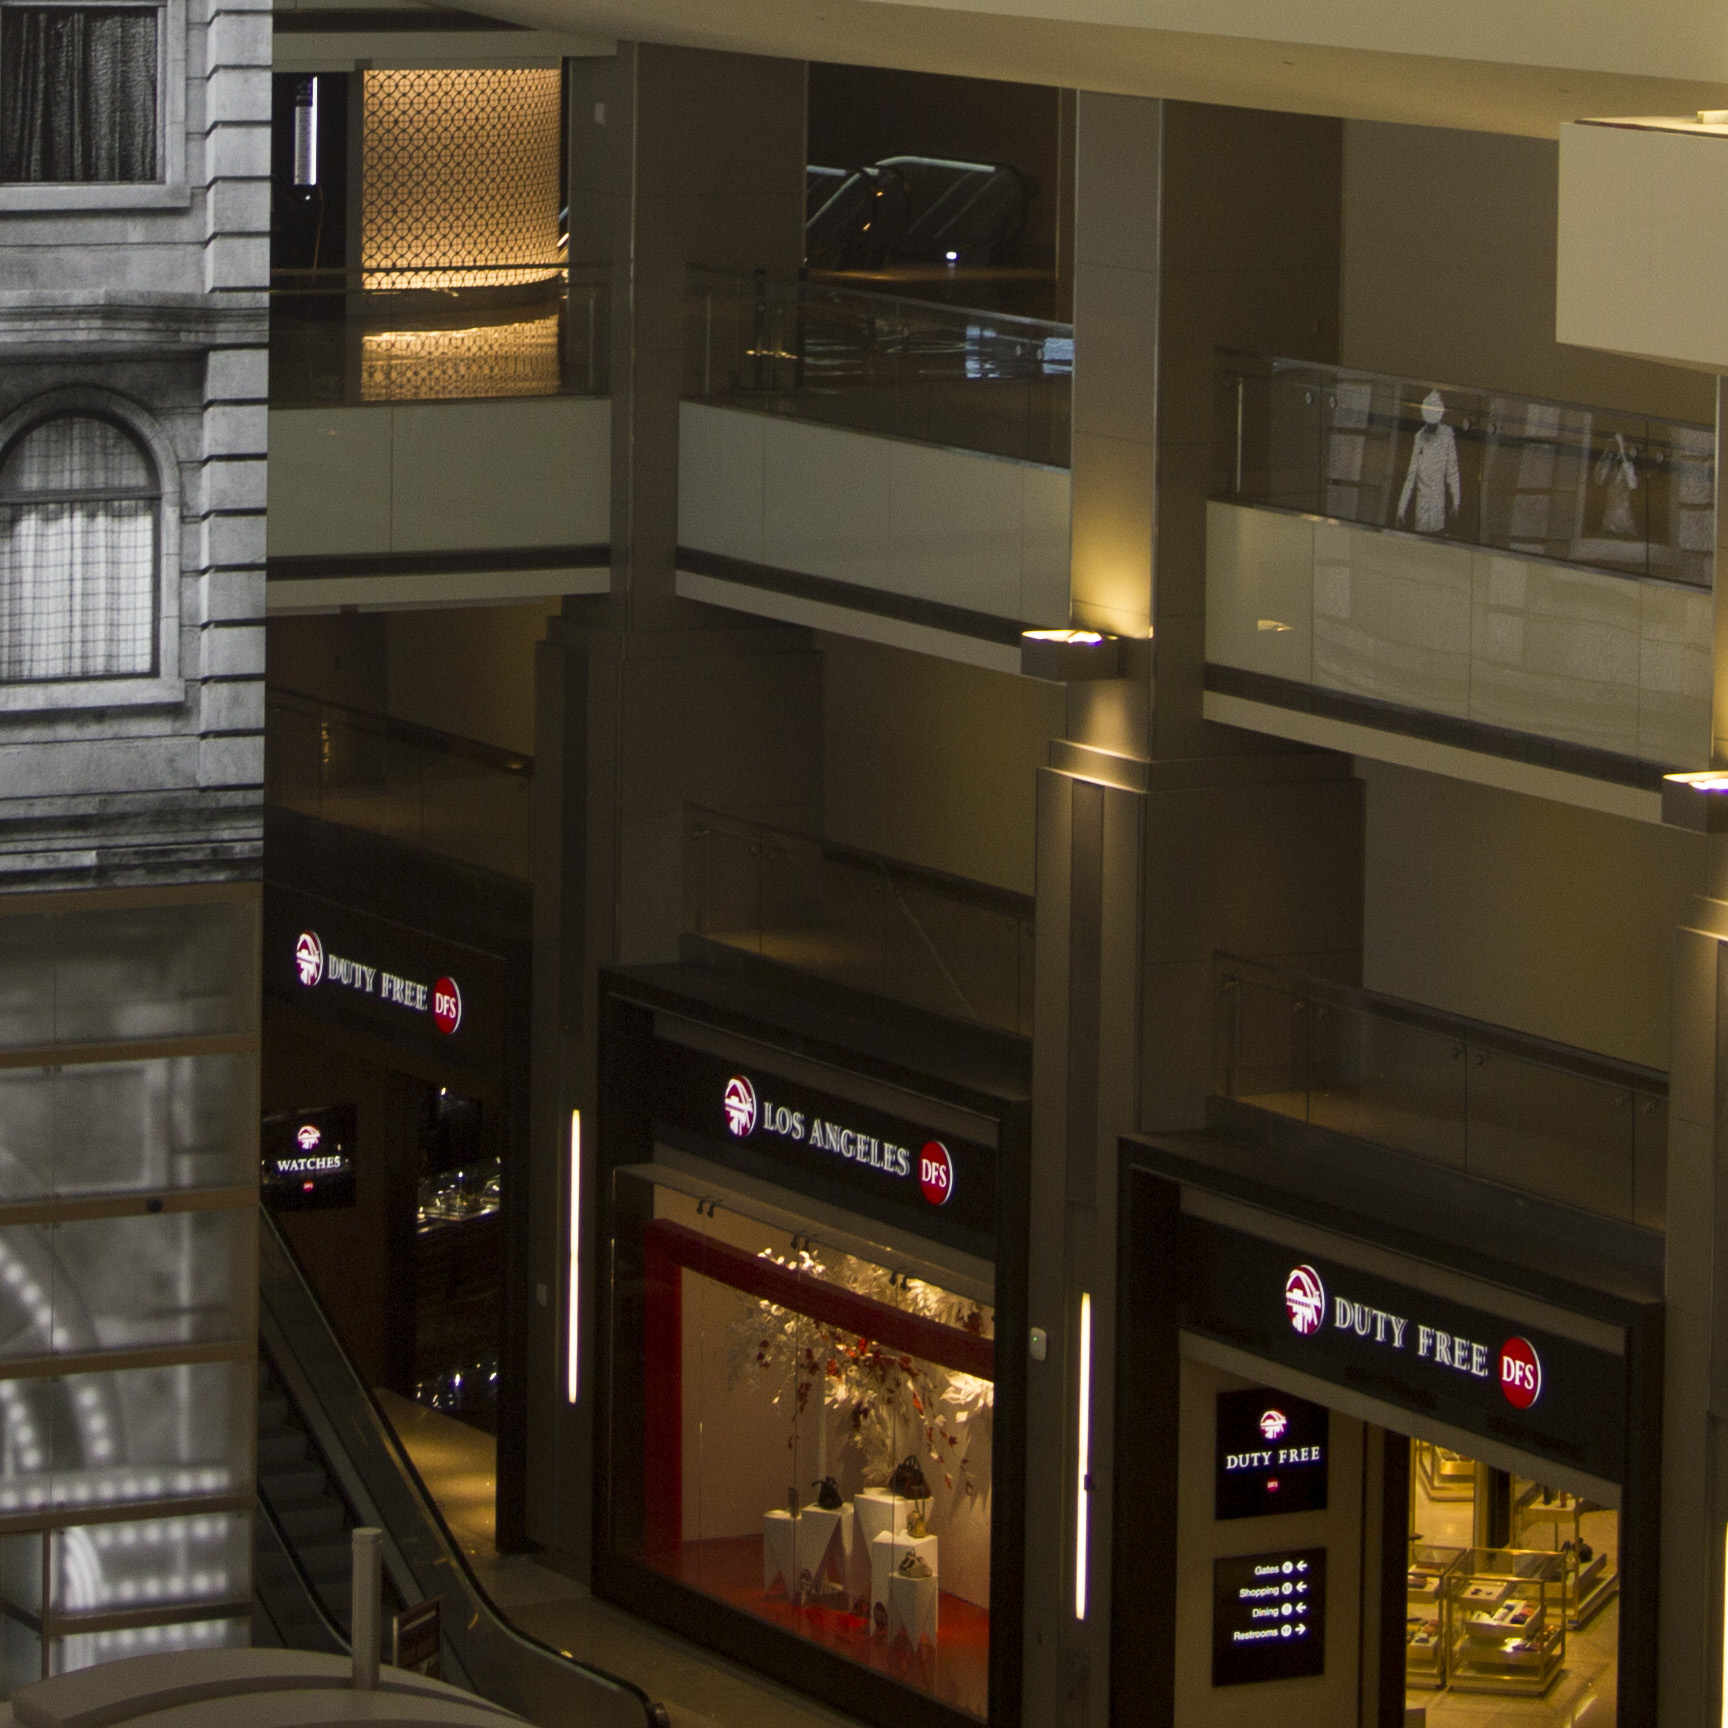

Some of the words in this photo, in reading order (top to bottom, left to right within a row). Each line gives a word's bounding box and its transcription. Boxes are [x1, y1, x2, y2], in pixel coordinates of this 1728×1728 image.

[327, 954, 375, 992] DUTY
[381, 973, 429, 1011] FREE
[435, 992, 457, 1018] DFS
[762, 1101, 805, 1140] LOS
[808, 1117, 911, 1177] ANGELES
[920, 1156, 949, 1191] DFS
[277, 1156, 341, 1172] WATCHES
[1334, 1296, 1409, 1349] DUTY
[1417, 1324, 1489, 1378] FREE
[1500, 1357, 1535, 1390] DFS
[1226, 1451, 1272, 1470] DUTY
[1278, 1446, 1320, 1464] FREE
[1254, 1565, 1280, 1576] Gates
[1239, 1586, 1280, 1599] Shopping
[1251, 1606, 1280, 1619] Dining
[1233, 1628, 1279, 1642] Restrooms
